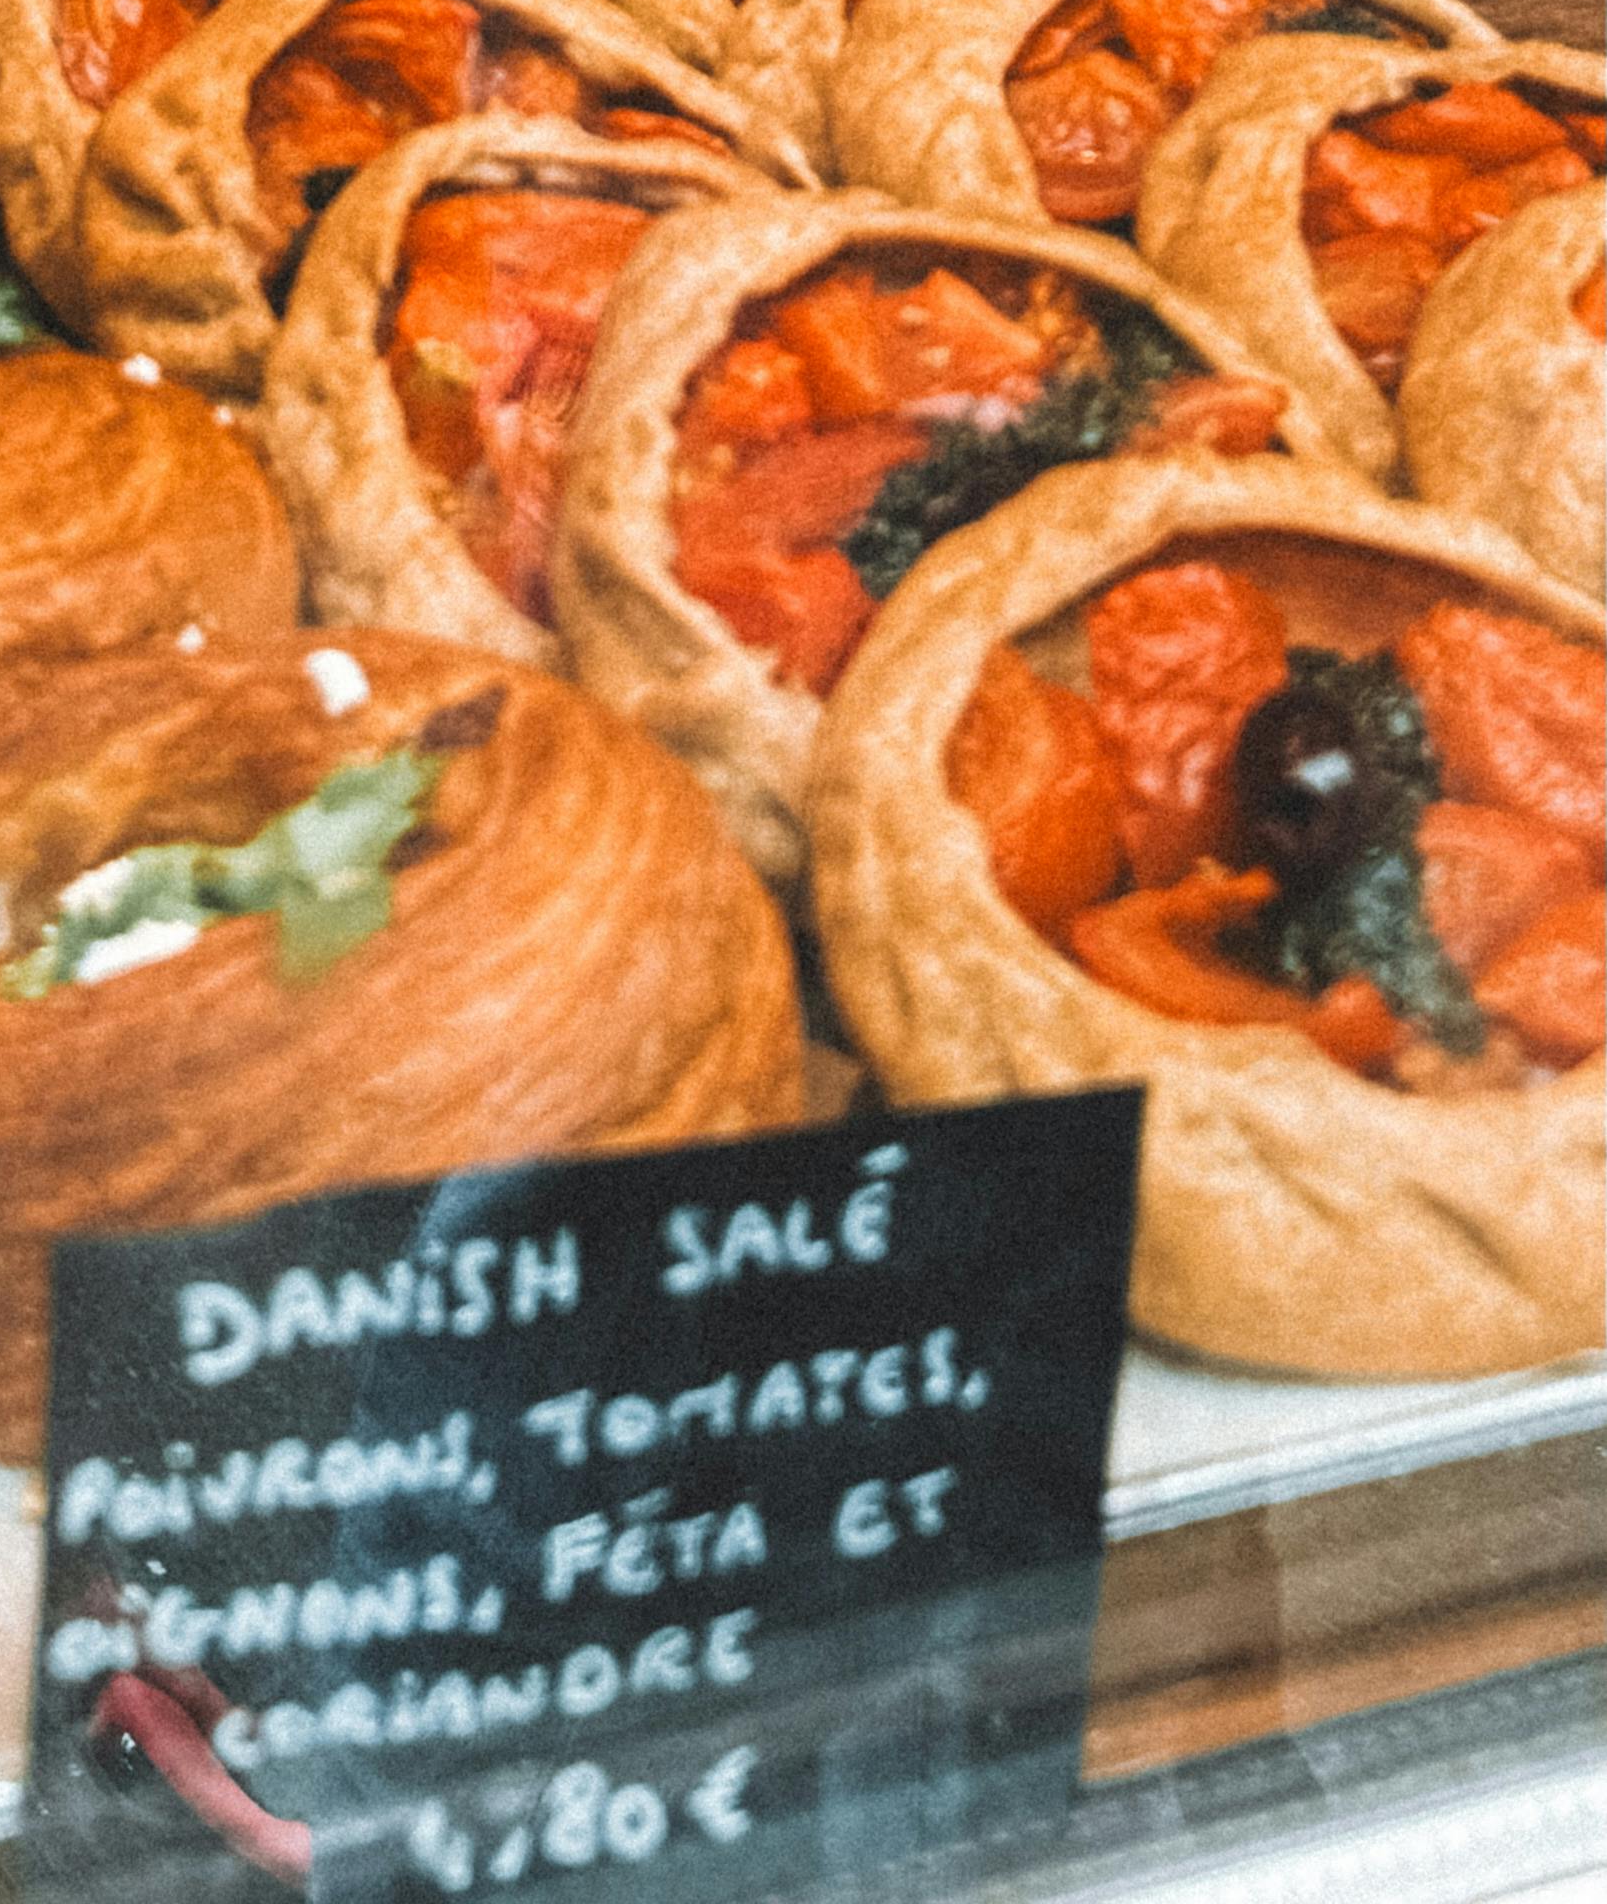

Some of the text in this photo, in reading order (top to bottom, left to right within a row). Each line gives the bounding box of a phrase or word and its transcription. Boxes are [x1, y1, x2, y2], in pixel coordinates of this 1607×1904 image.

[178, 1142, 910, 1386] DANISH SALÉ
[520, 1325, 990, 1465] TOMATES,
[831, 1464, 957, 1558] ET
